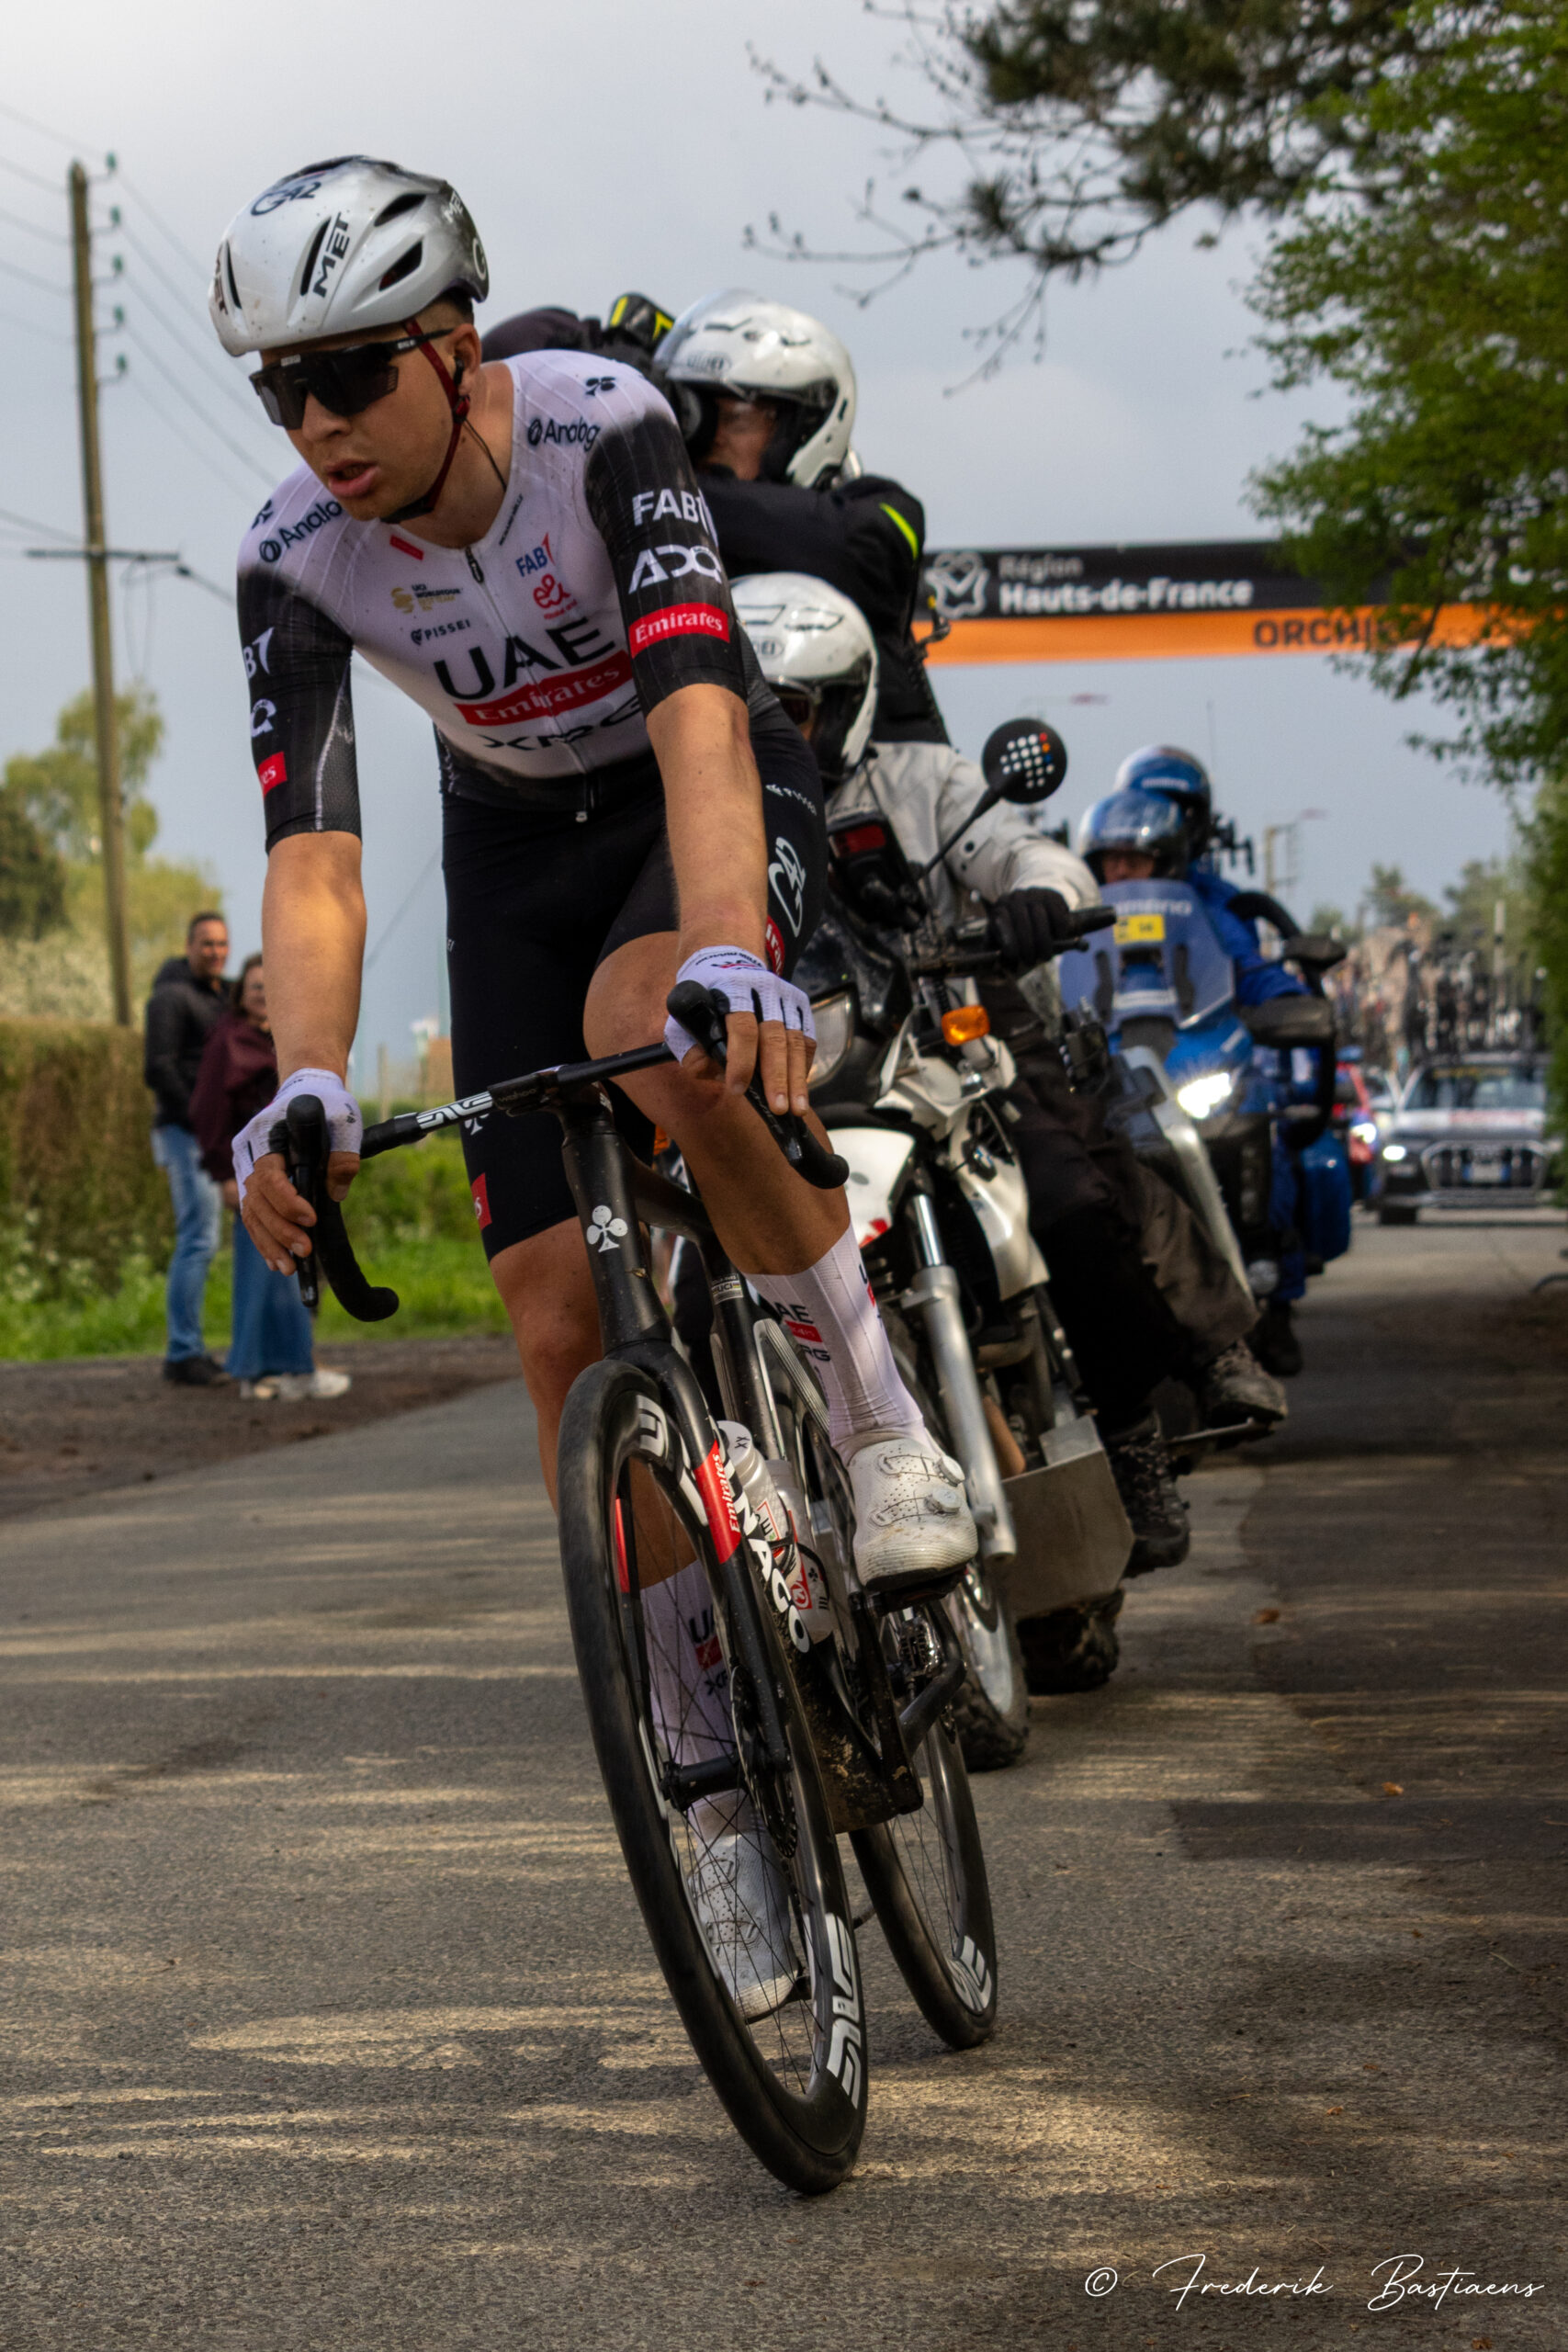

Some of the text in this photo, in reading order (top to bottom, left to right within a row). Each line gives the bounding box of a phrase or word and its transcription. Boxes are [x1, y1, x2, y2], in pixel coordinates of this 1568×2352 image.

[312, 211, 350, 299] MET
[278, 501, 343, 548] Analo
[999, 576, 1254, 614] Hauts-de-France
[424, 619, 470, 640] PISSEI
[635, 610, 724, 645] Emirates
[1254, 616, 1371, 647] ORCHI
[434, 616, 616, 700] UAE
[474, 668, 621, 722] Emirates
[773, 1302, 814, 1325] AE
[797, 1344, 831, 1362] RG
[713, 1453, 741, 1533] Emirates
[732, 1488, 810, 1654] NAGO
